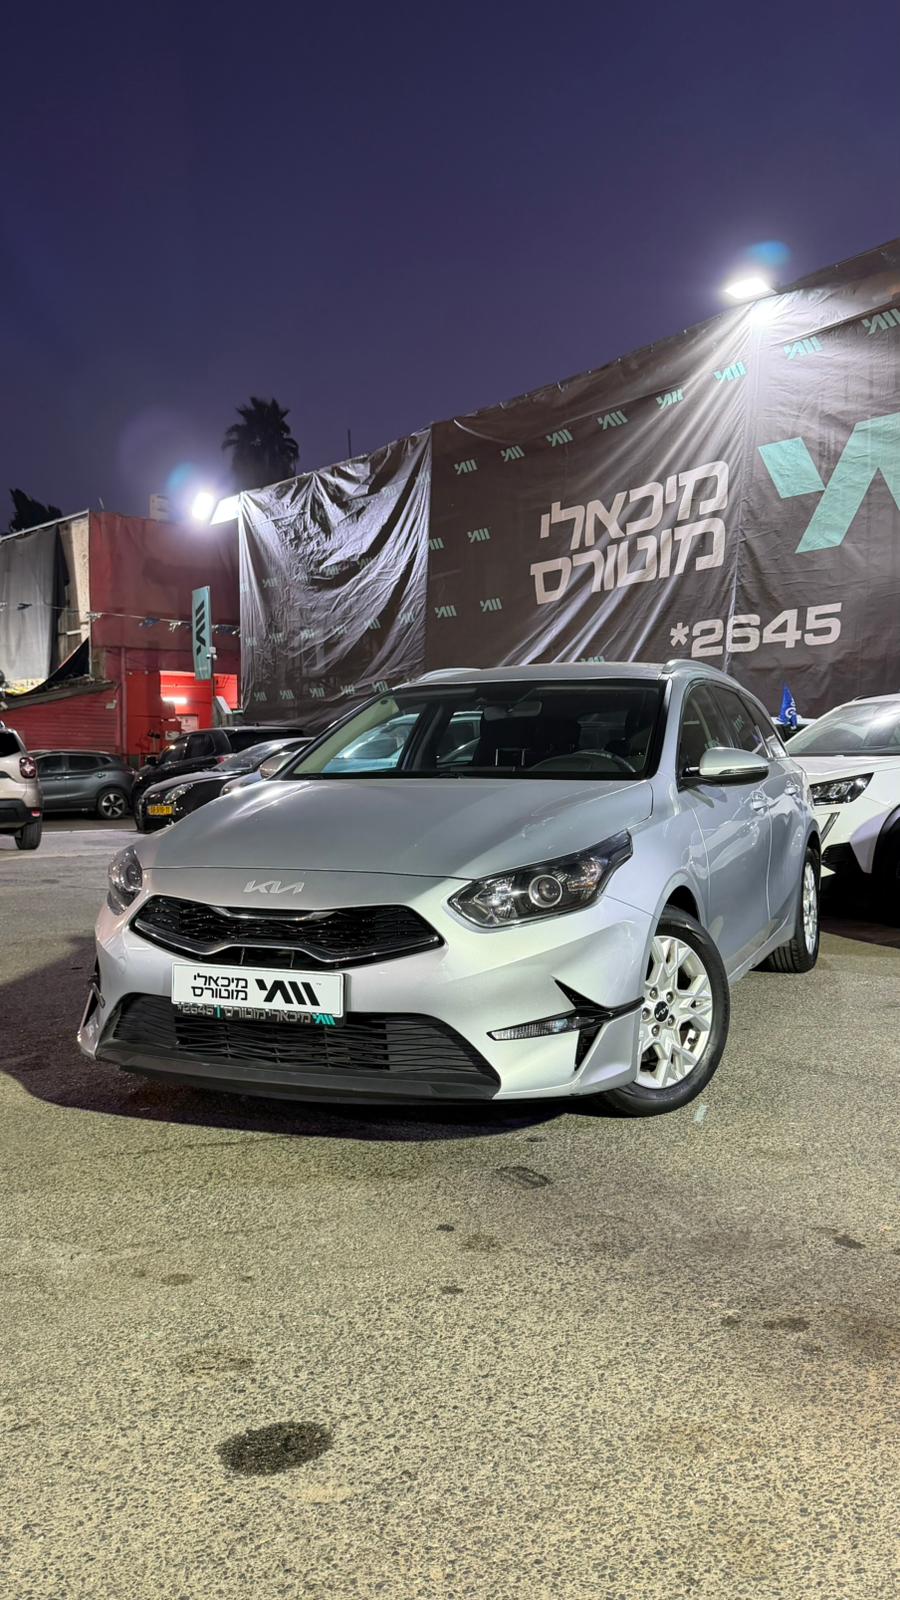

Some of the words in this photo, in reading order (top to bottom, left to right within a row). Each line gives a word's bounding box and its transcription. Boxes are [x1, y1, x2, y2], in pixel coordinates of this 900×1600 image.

[541, 461, 730, 549] מיכאלי
[530, 517, 726, 604] מוטורס
[193, 973, 249, 989] מיכאלי
[191, 986, 249, 1001] מוטורס
[223, 1007, 266, 1019] מוטורס
[267, 1009, 312, 1023] מיכאלי
